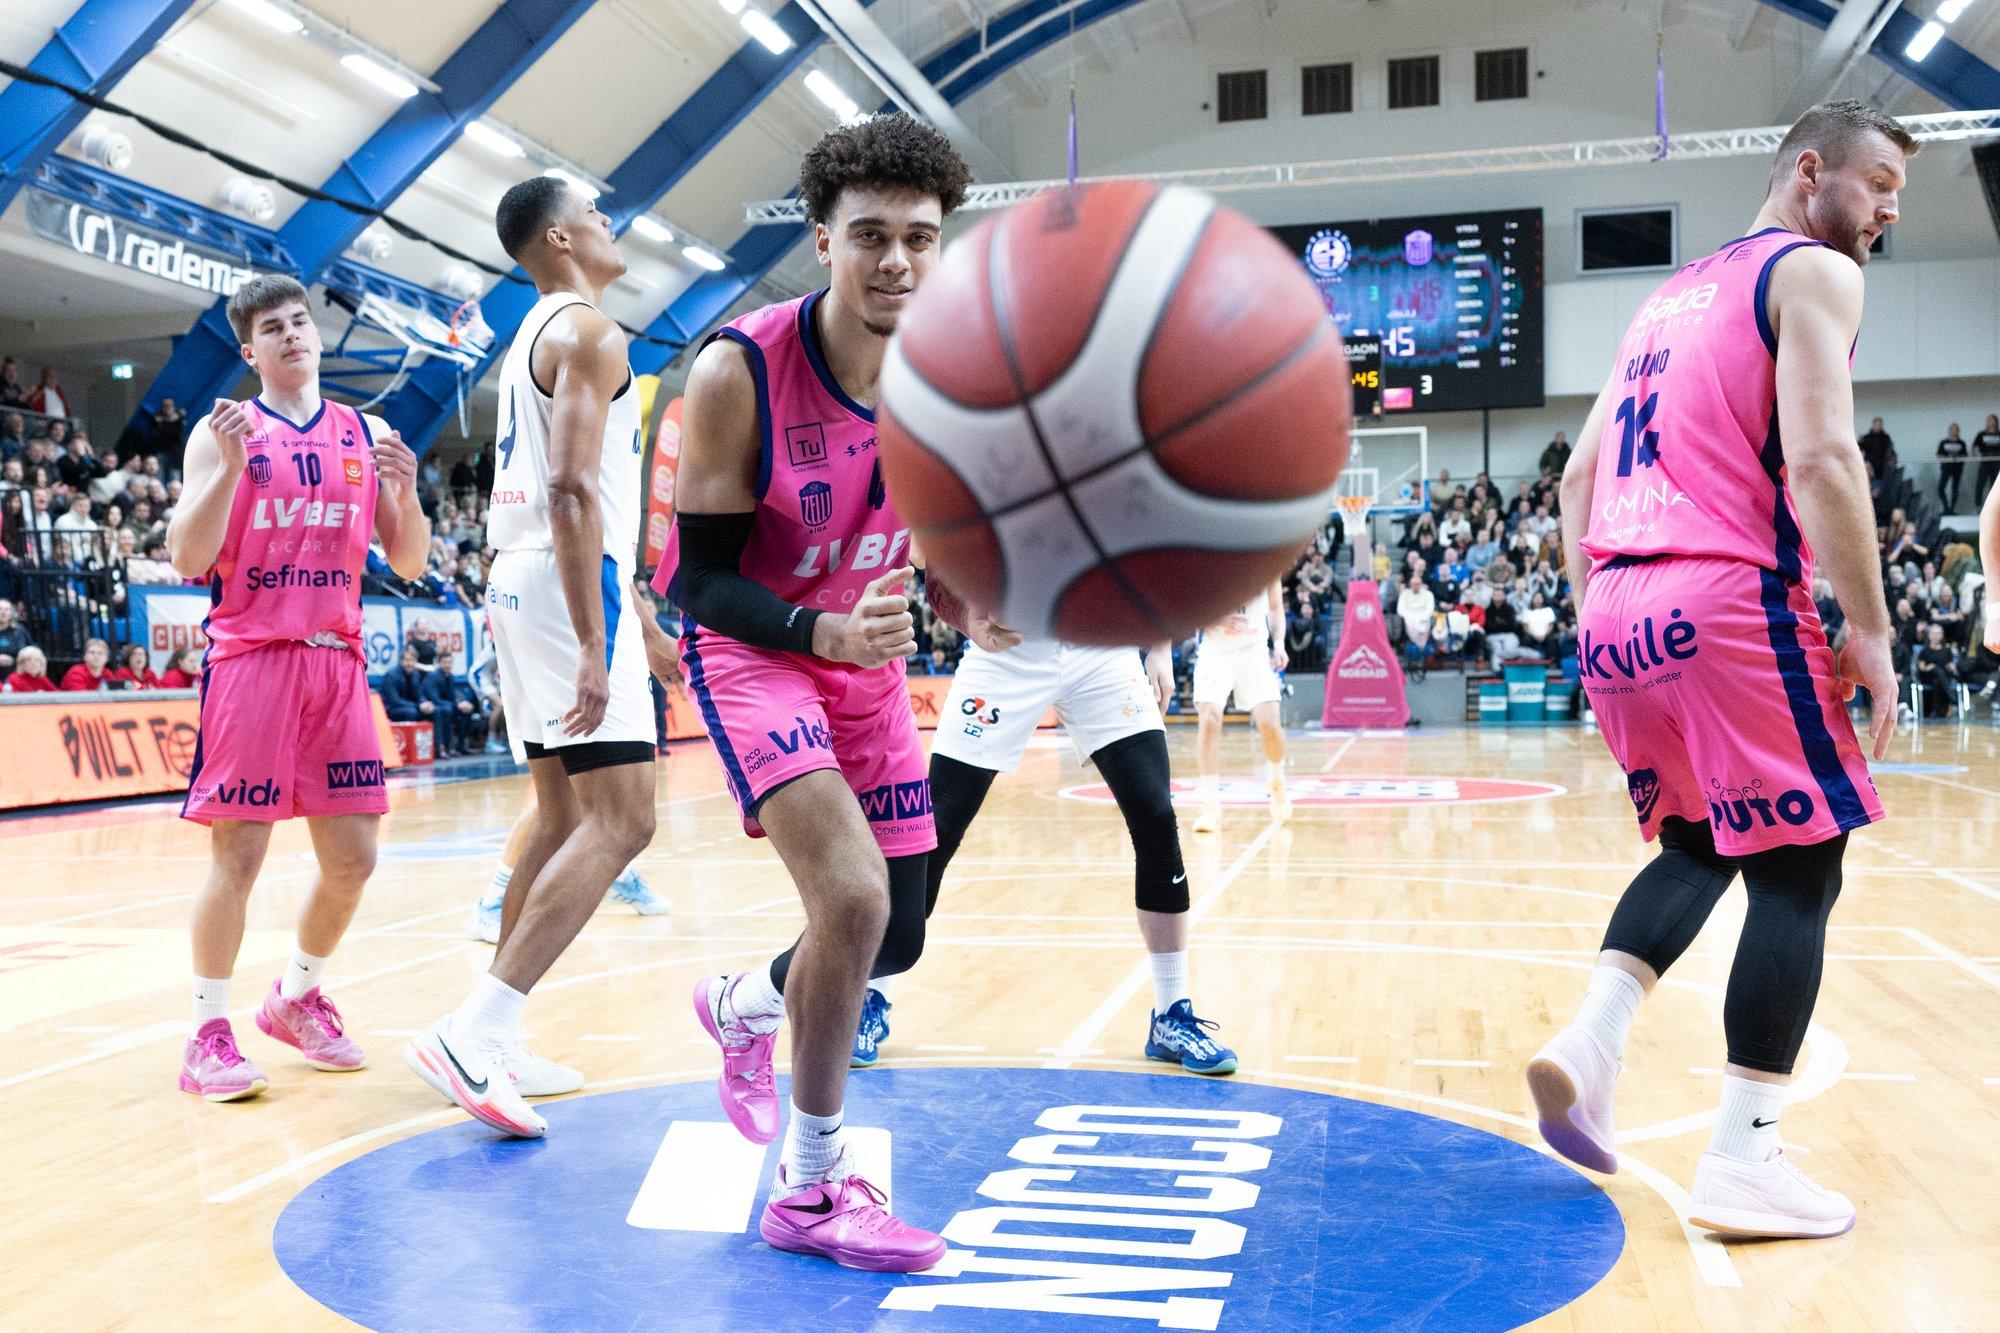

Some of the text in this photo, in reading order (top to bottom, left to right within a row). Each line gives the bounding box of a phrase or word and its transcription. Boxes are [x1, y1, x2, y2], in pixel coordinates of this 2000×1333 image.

[121, 232, 262, 296] radema
[1615, 391, 1661, 477] 14
[796, 440, 821, 458] Tu
[292, 452, 322, 486] 10
[490, 491, 527, 505] NDA
[253, 497, 361, 530] LVBET
[267, 540, 350, 554] SCORE
[792, 528, 910, 578] LVBE
[1654, 670, 1683, 685] water
[744, 747, 761, 763] eco
[747, 751, 778, 775] baltia
[878, 1105, 1283, 1331] NOCCO
